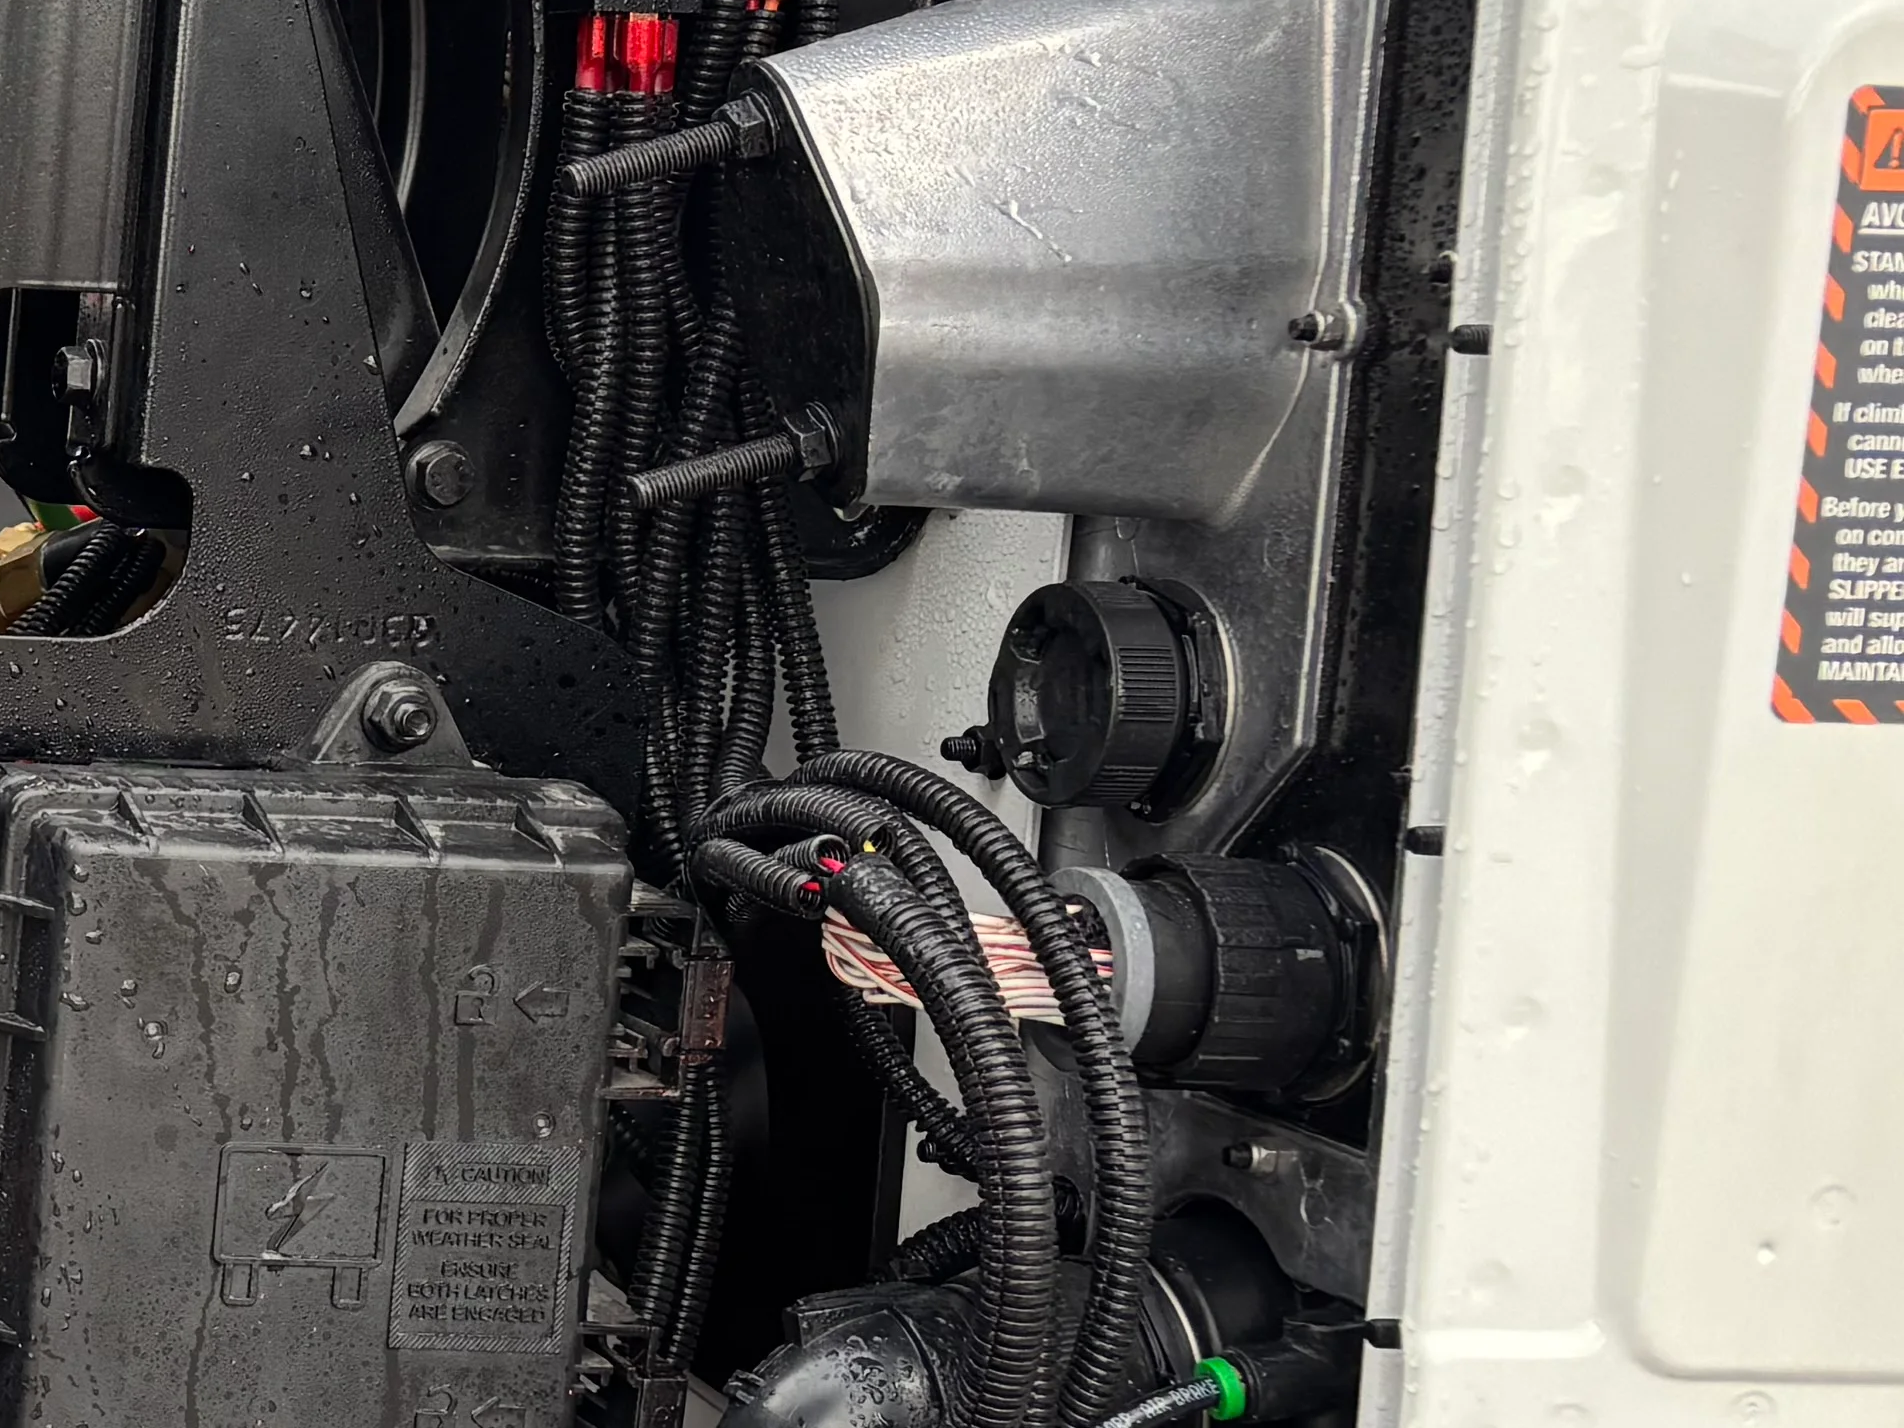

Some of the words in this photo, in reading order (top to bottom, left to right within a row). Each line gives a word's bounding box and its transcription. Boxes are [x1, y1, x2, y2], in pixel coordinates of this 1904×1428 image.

[1860, 339, 1889, 357] on
[1833, 401, 1852, 423] If
[1844, 458, 1888, 480] USE
[1820, 495, 1891, 518] Before
[1835, 528, 1864, 546] on
[1832, 552, 1880, 576] they
[1825, 607, 1865, 627] will
[1821, 634, 1863, 655] and
[460, 1167, 548, 1186] CAUTION
[423, 1208, 463, 1225] FOR
[467, 1209, 548, 1228] PROPER
[411, 1230, 503, 1249] WEATHER
[507, 1233, 557, 1251] SEAL
[441, 1260, 519, 1279] ENSURE
[407, 1282, 461, 1299] BOTH
[464, 1284, 550, 1302] LATCHES
[408, 1304, 447, 1321] ARE
[451, 1305, 545, 1323] ENGAGED
[1170, 1370, 1218, 1413] BRAKE
